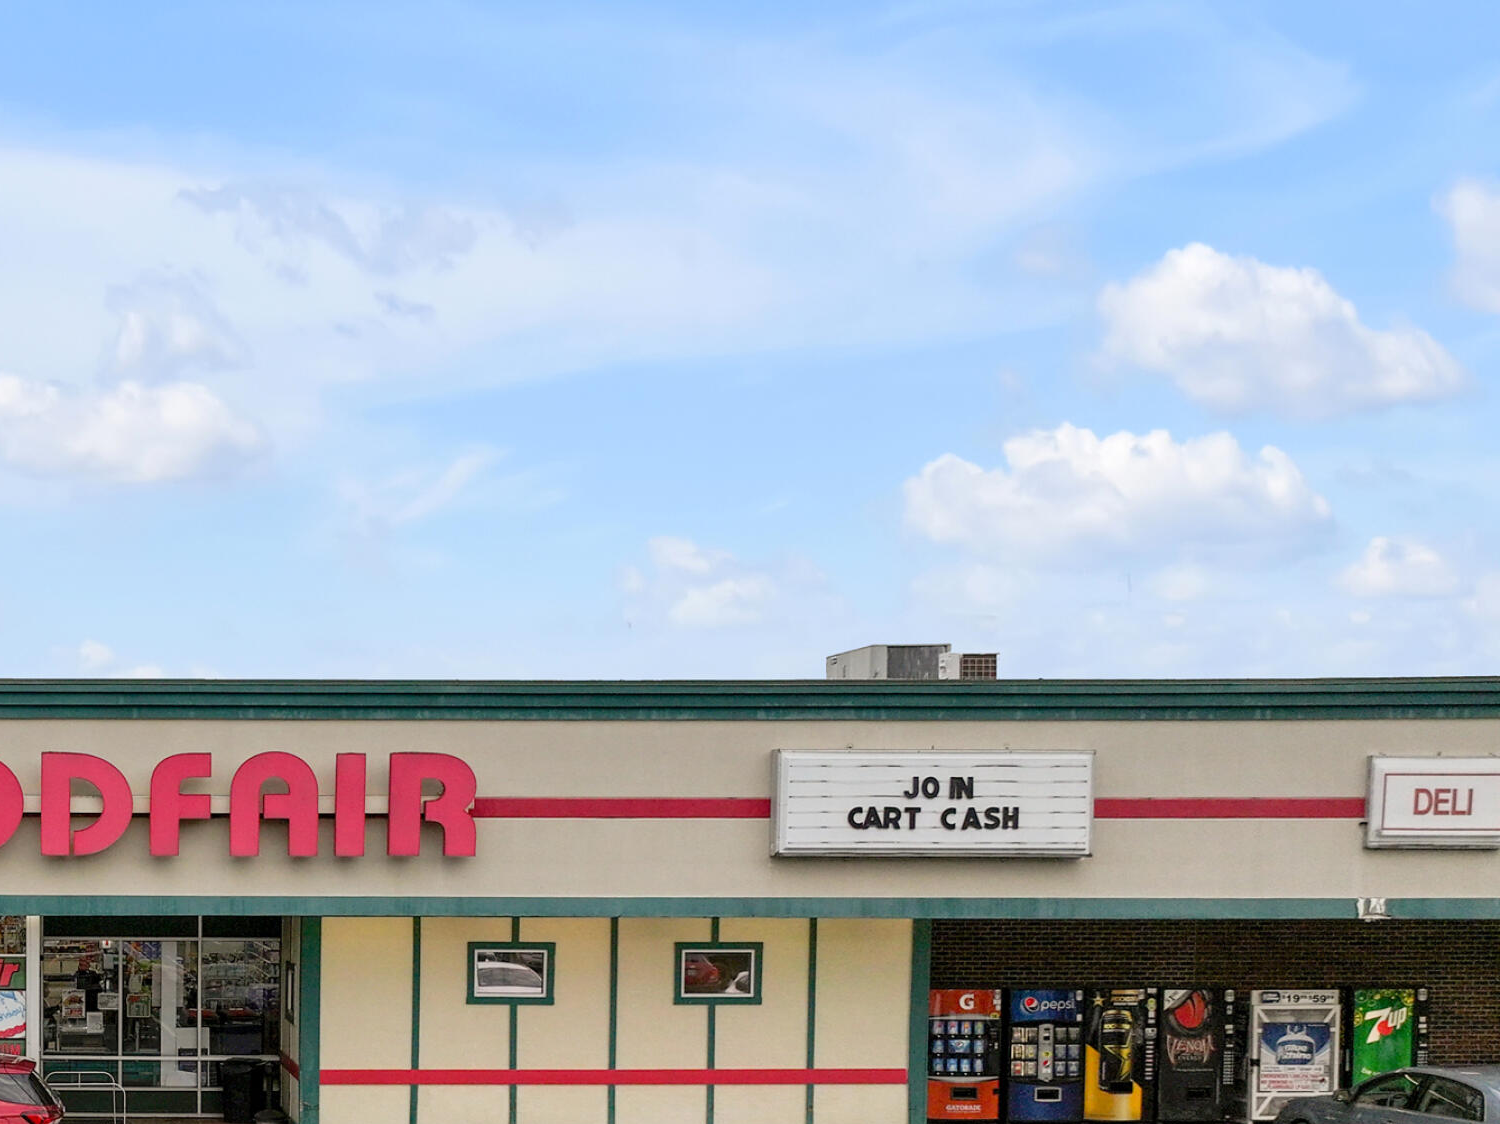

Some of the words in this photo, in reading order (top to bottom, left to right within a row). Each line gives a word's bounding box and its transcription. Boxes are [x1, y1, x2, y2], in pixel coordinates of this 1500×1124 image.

[1413, 788, 1473, 815] DELI
[848, 806, 921, 830] CART
[940, 806, 1020, 830] CASH
[959, 993, 975, 1010] G
[1040, 998, 1076, 1011] pepsi
